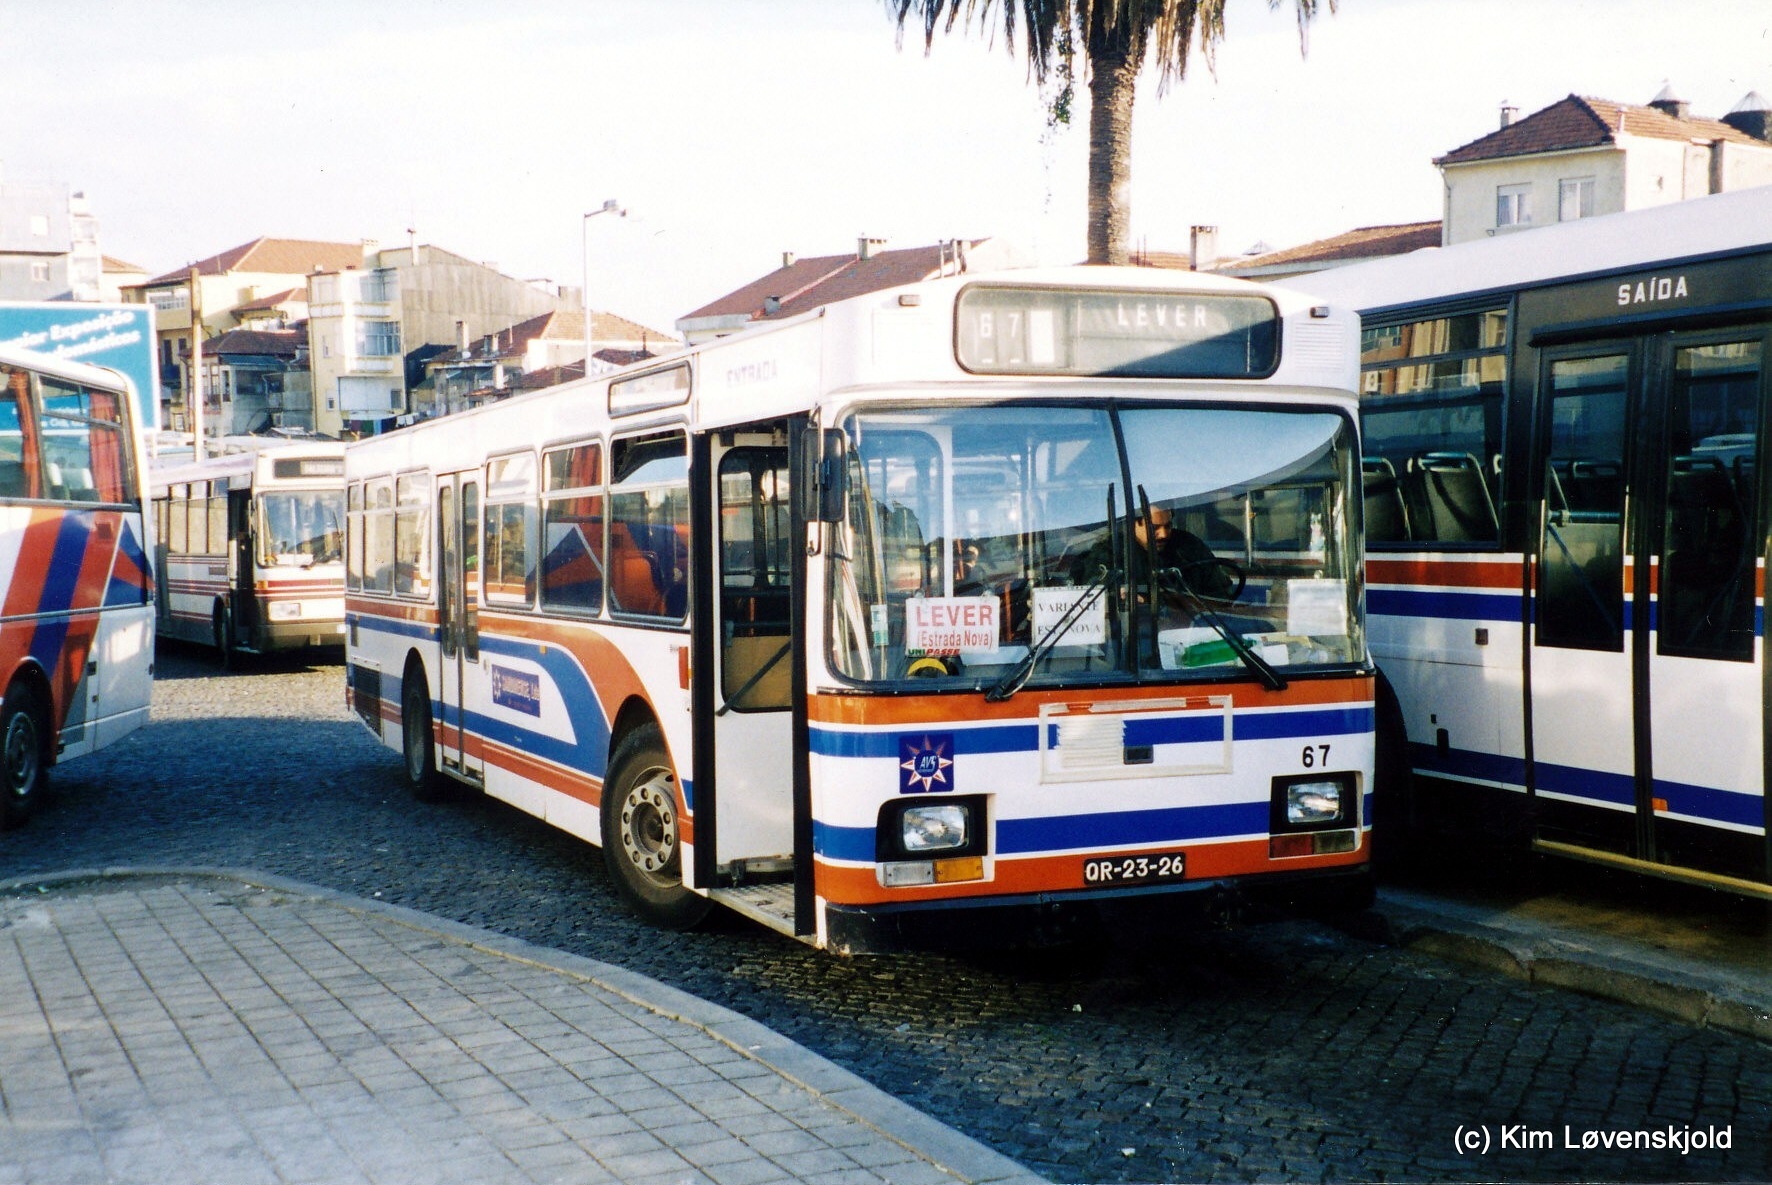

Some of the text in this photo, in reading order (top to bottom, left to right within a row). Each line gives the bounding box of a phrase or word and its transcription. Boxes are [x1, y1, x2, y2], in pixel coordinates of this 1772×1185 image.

[1617, 275, 1688, 306] SAÍDA
[1117, 302, 1208, 327] LEVER
[916, 604, 993, 627] LEVER
[917, 629, 993, 650] (Estrada Nova)
[1302, 744, 1331, 768] 67
